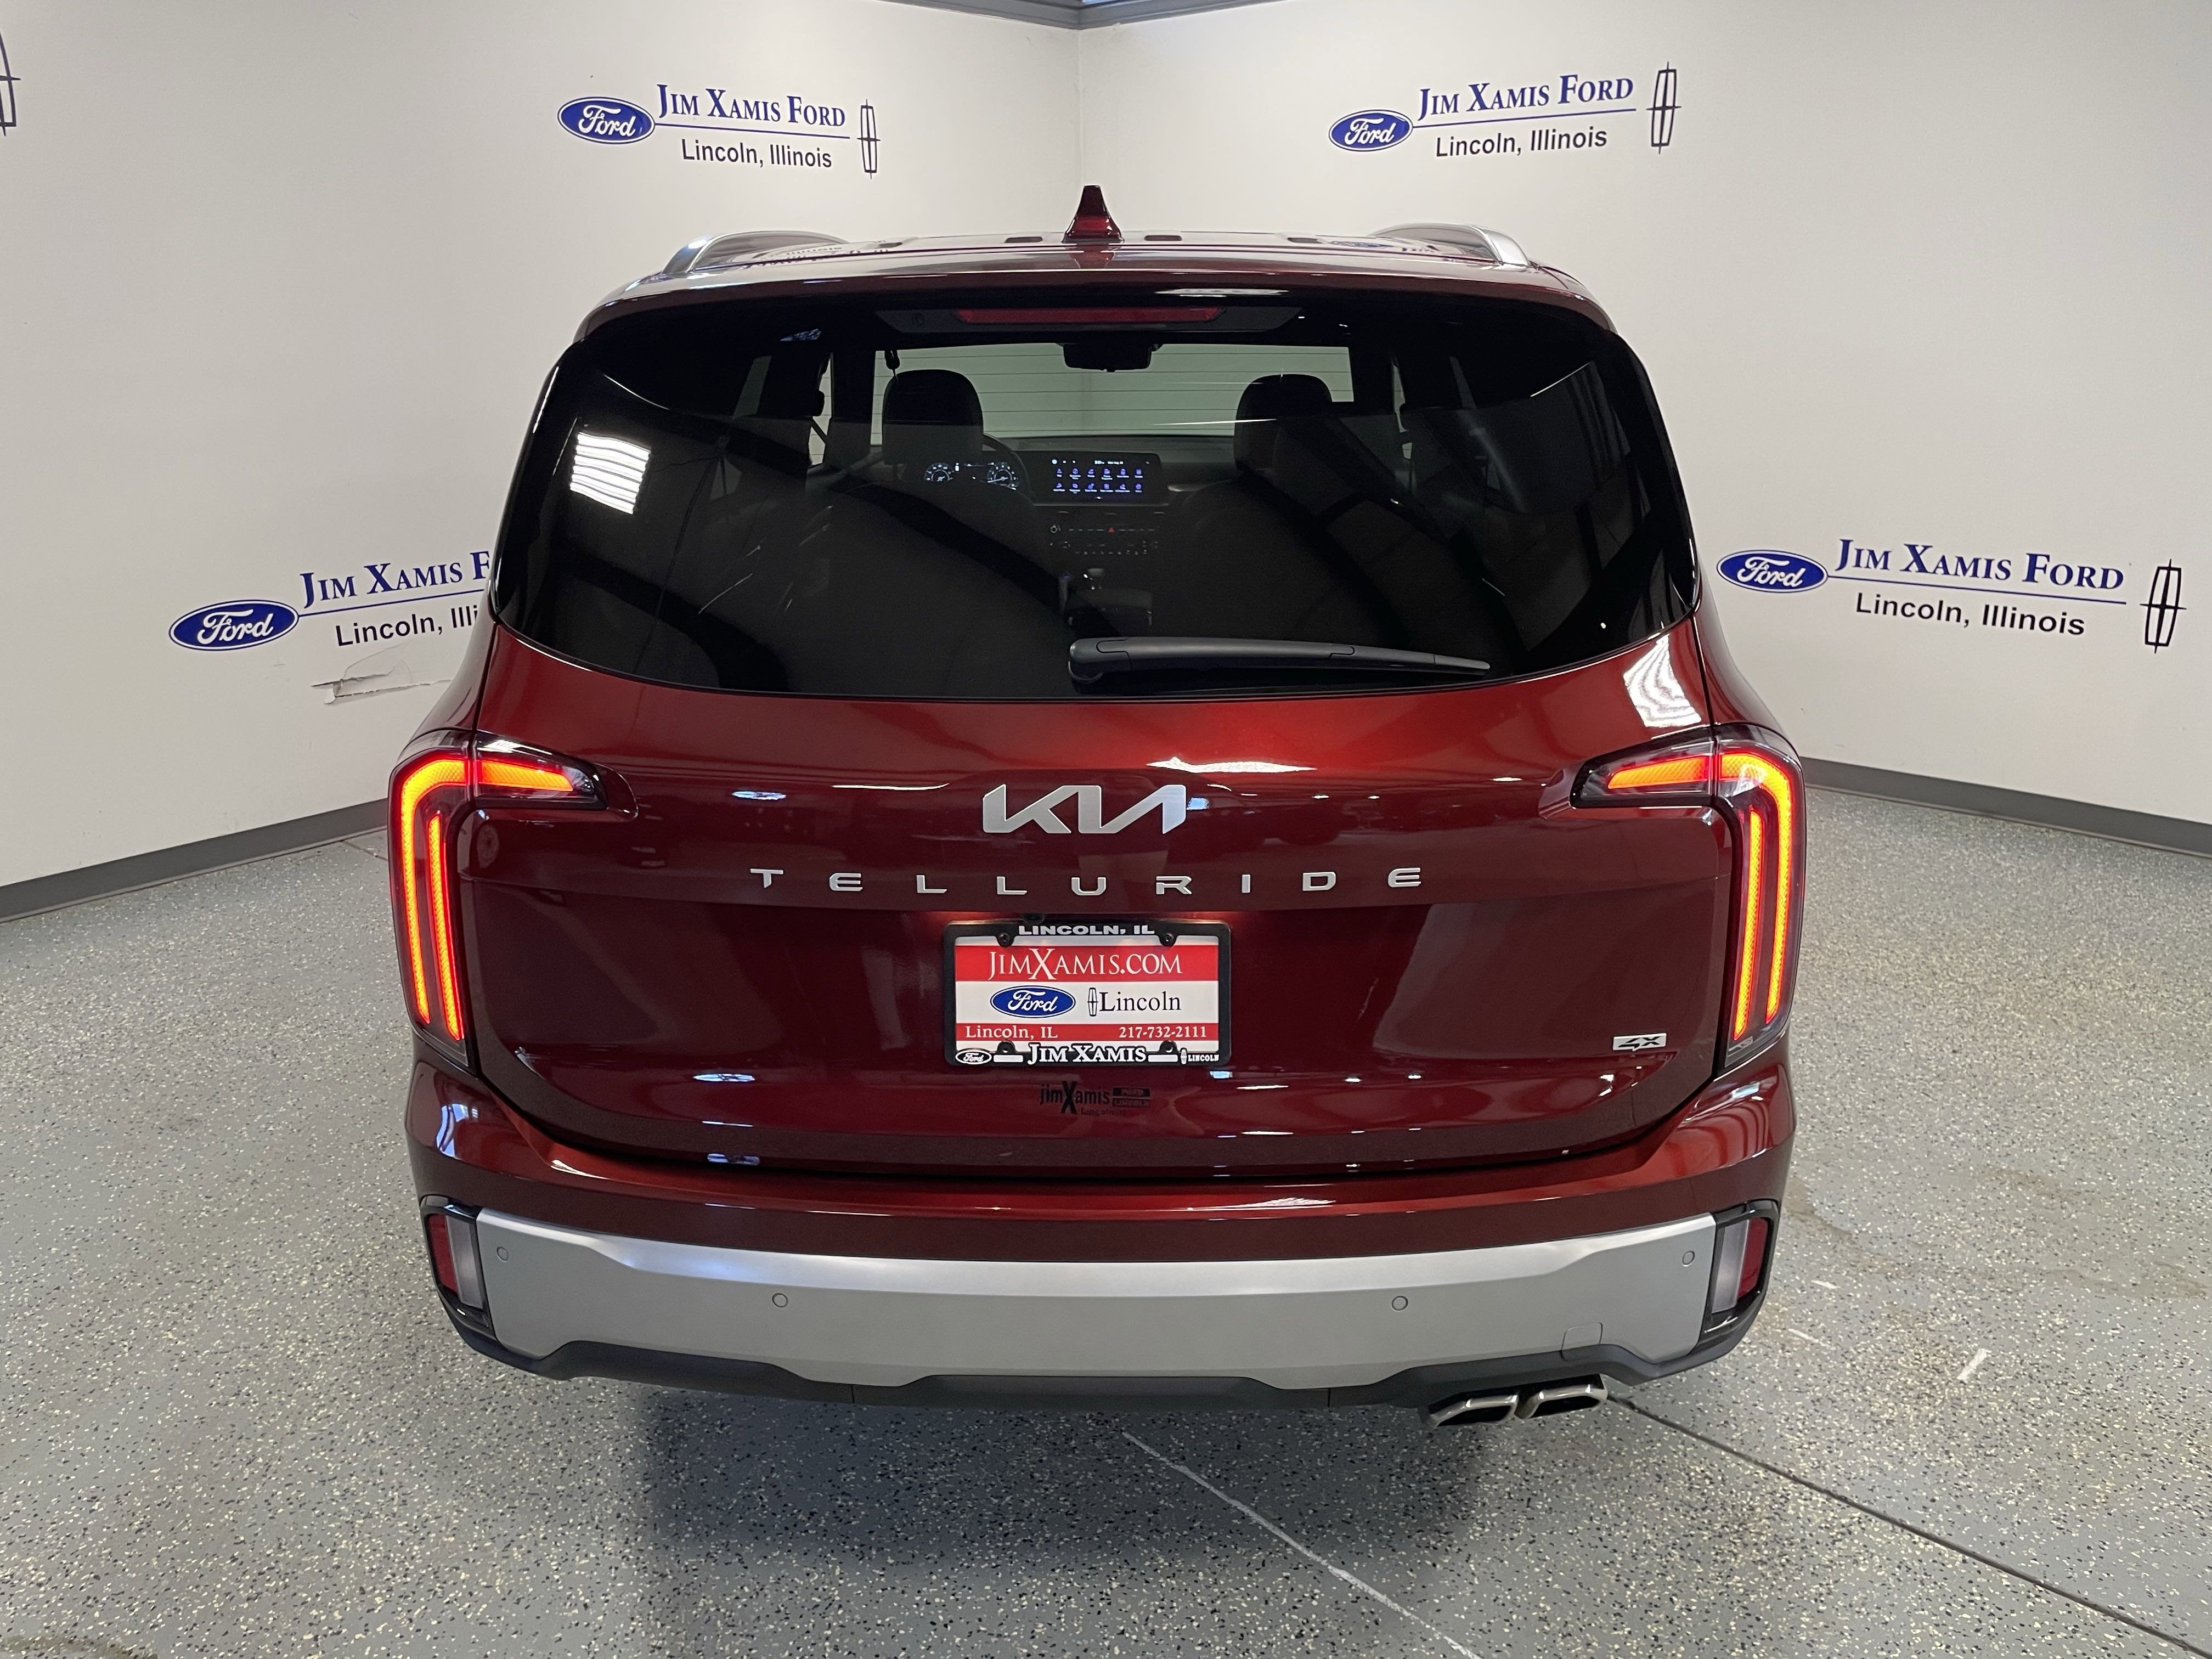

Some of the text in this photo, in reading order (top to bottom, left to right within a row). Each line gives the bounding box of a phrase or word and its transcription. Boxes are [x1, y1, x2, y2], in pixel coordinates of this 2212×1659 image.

[657, 84, 847, 127] JIM XAMIS FORD
[1418, 75, 1634, 121] JIM XAMIS FORD
[578, 105, 636, 137] Ford
[1344, 118, 1395, 145] Ford
[682, 139, 832, 168] Lincoln, Illinois
[1436, 126, 1608, 157] Lincoln, Illinois
[1737, 558, 1806, 588] Ford
[1835, 539, 2124, 590] JIM XAMIS FORD
[300, 572, 358, 609] JIM
[364, 562, 463, 595] XAMIS
[197, 609, 274, 645] Ford
[1856, 592, 2086, 635] Lincoln, Illinois
[335, 614, 442, 646] Lincoln,
[982, 783, 1186, 834] KIA
[750, 867, 1421, 896] TELLURIDE
[1019, 925, 1155, 935] LINCOLN, IL
[988, 948, 1183, 980] JIMXAMIS.COM
[1008, 991, 1058, 1012] Ford
[1099, 991, 1182, 1012] Lincoln
[965, 1025, 1058, 1040] Lincoln, IL
[1119, 1026, 1207, 1039] 217-732-2111
[1028, 1043, 1147, 1065] JIM XAMIS
